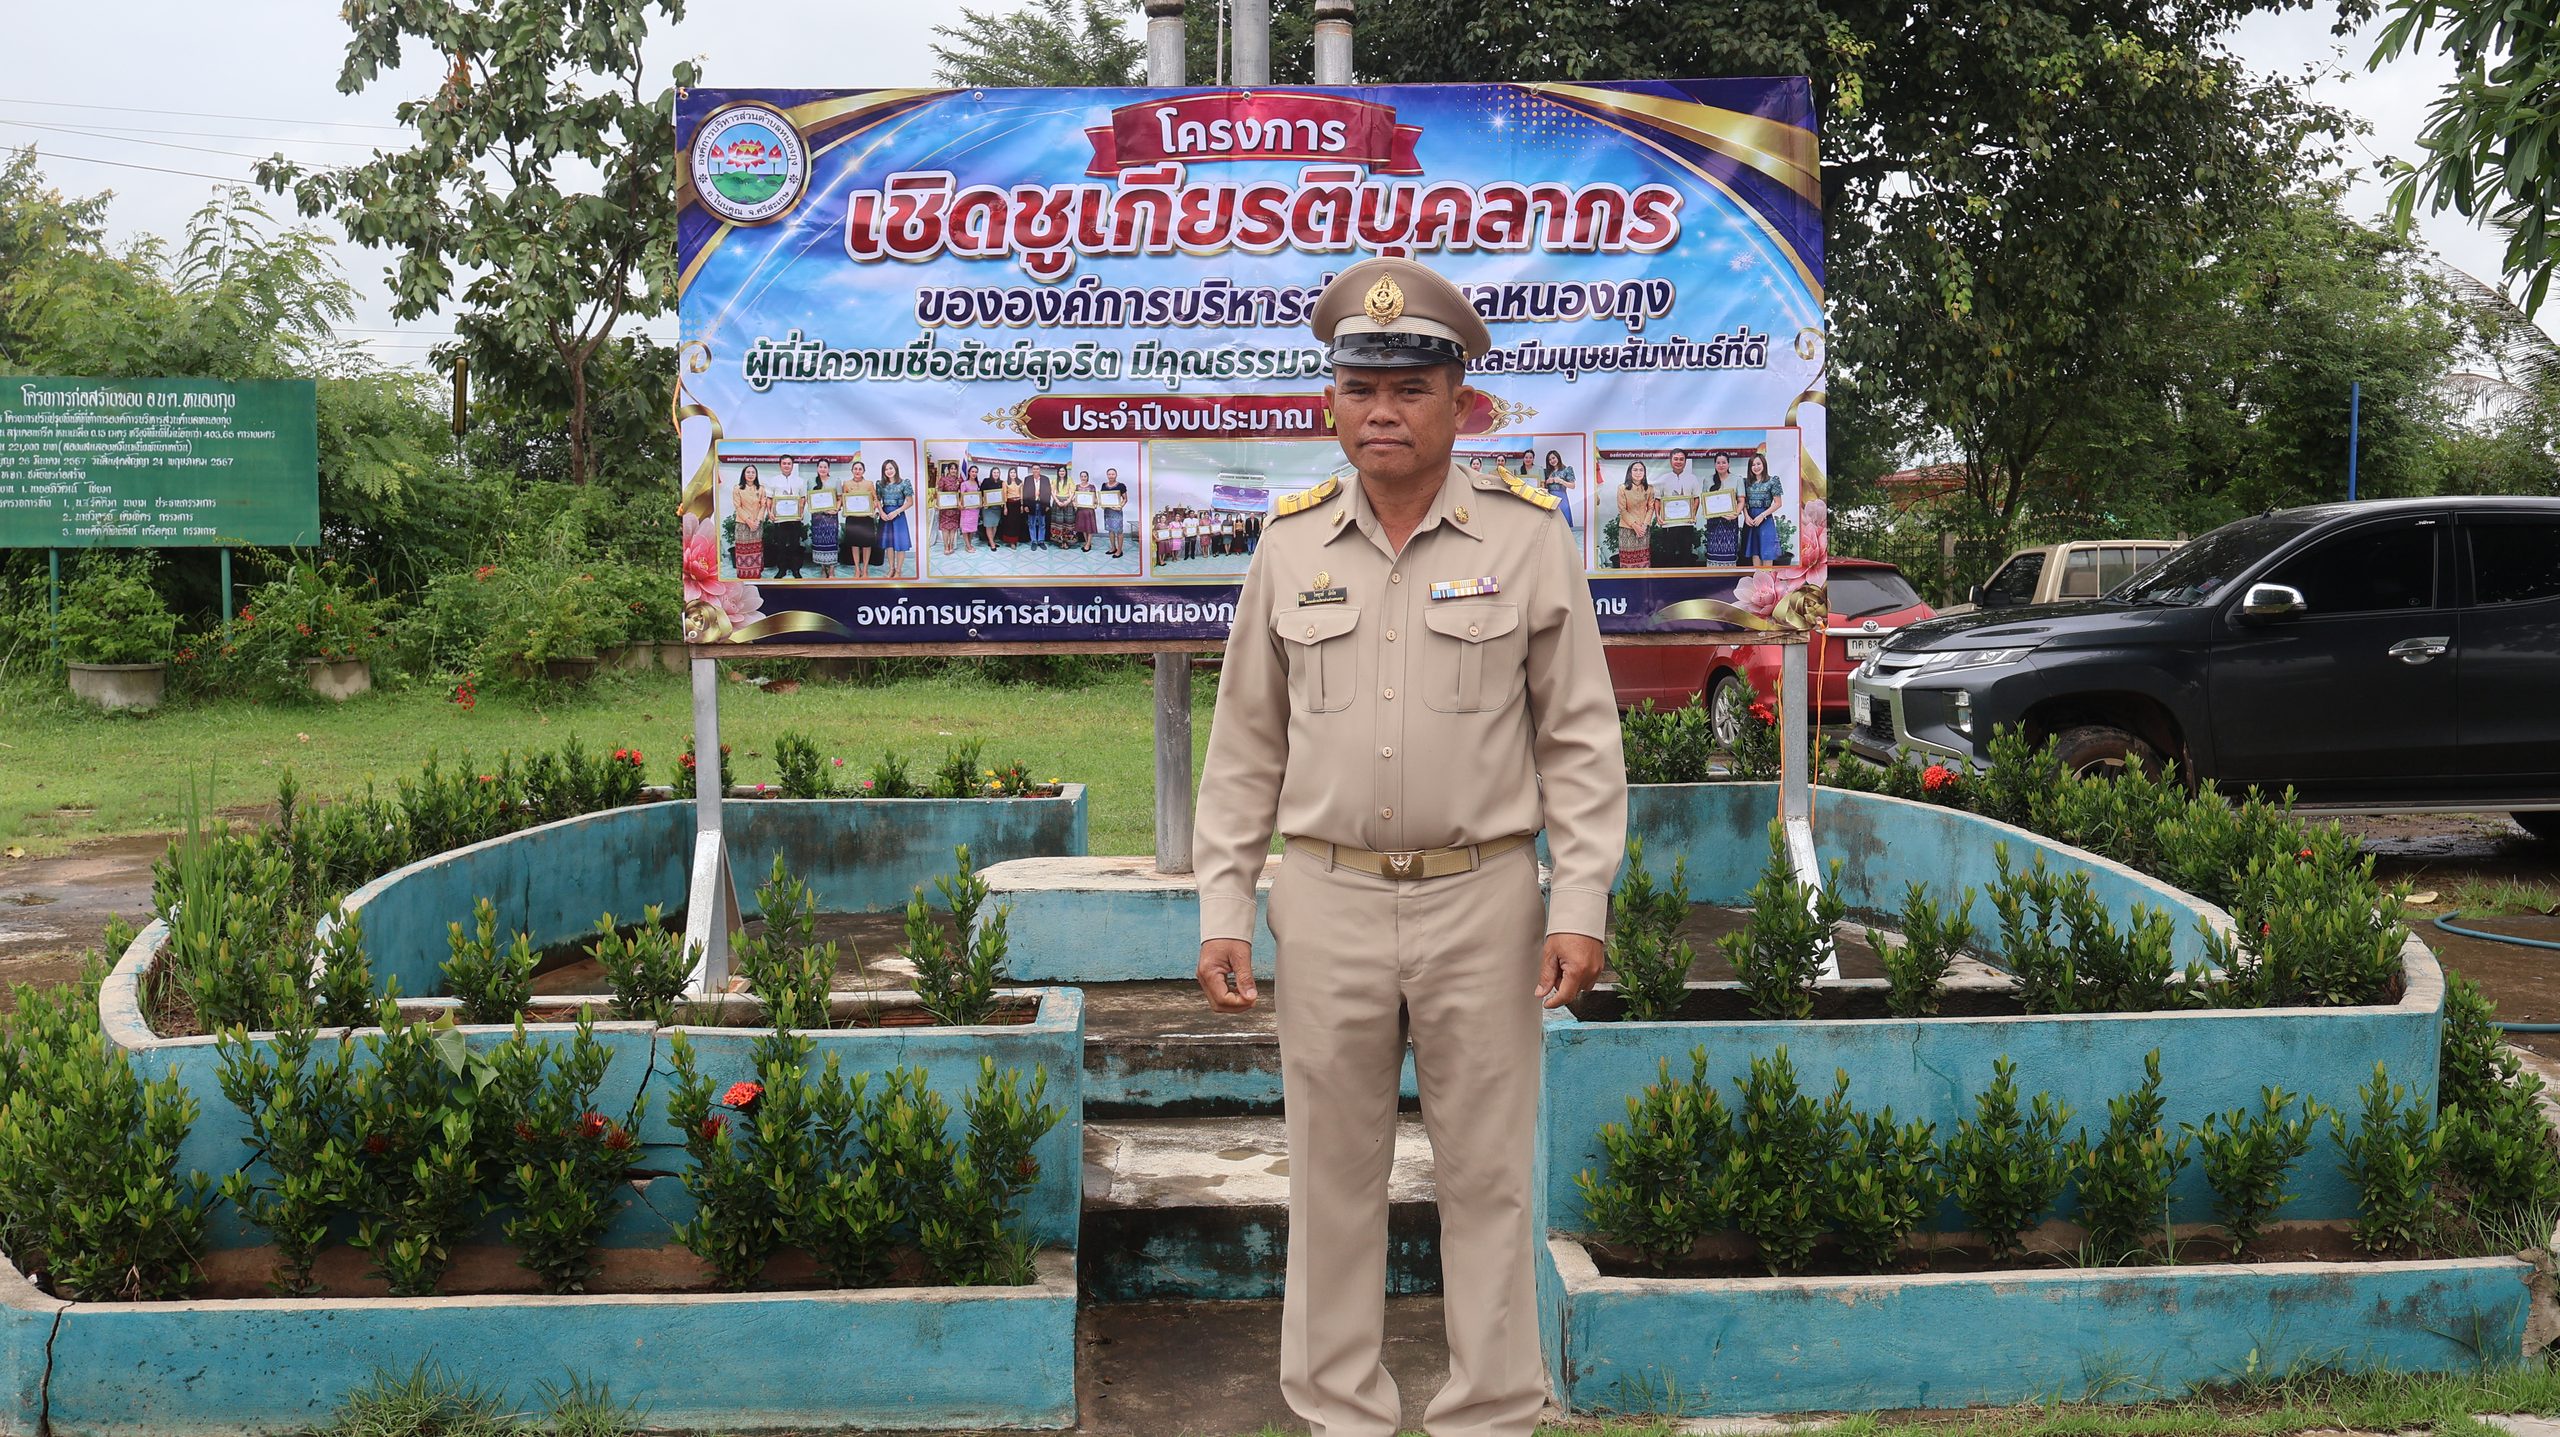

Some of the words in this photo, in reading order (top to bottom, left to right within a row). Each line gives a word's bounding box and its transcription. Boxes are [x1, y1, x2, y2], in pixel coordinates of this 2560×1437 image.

[1157, 108, 1346, 153] โครงการ
[845, 163, 1683, 279] เชิดชูเกียรติบุคลากร
[744, 331, 1119, 391] ผู้ที่มีความซื่อสัตย์สุจริต
[1062, 401, 1314, 432] ประจำปีงบประมาณ
